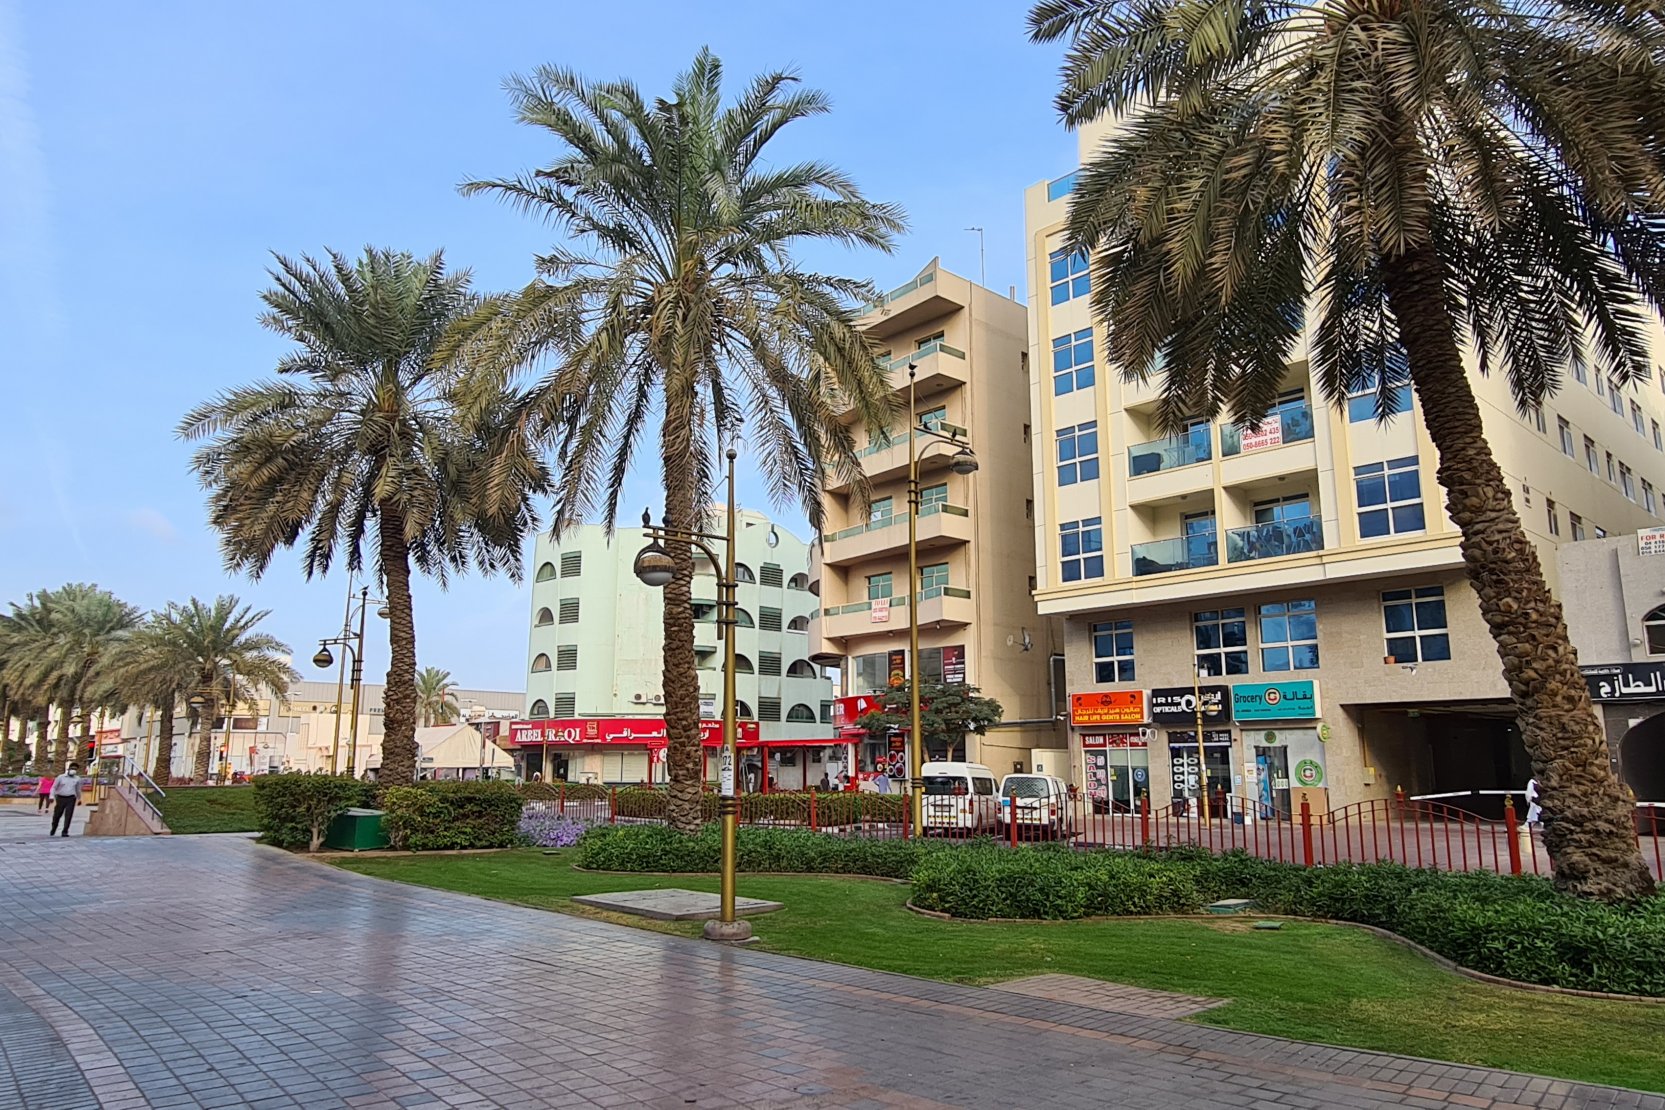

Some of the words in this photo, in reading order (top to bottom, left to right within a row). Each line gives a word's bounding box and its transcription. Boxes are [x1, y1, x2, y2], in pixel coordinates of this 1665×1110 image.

[1599, 671, 1662, 697] الطازج
[1153, 696, 1181, 704] IRIS
[1234, 693, 1262, 705] Grocery
[1283, 691, 1312, 702] بقالة
[1153, 705, 1182, 713] OPTICALS
[605, 728, 666, 742] العراقي
[1085, 735, 1104, 744] SALON
